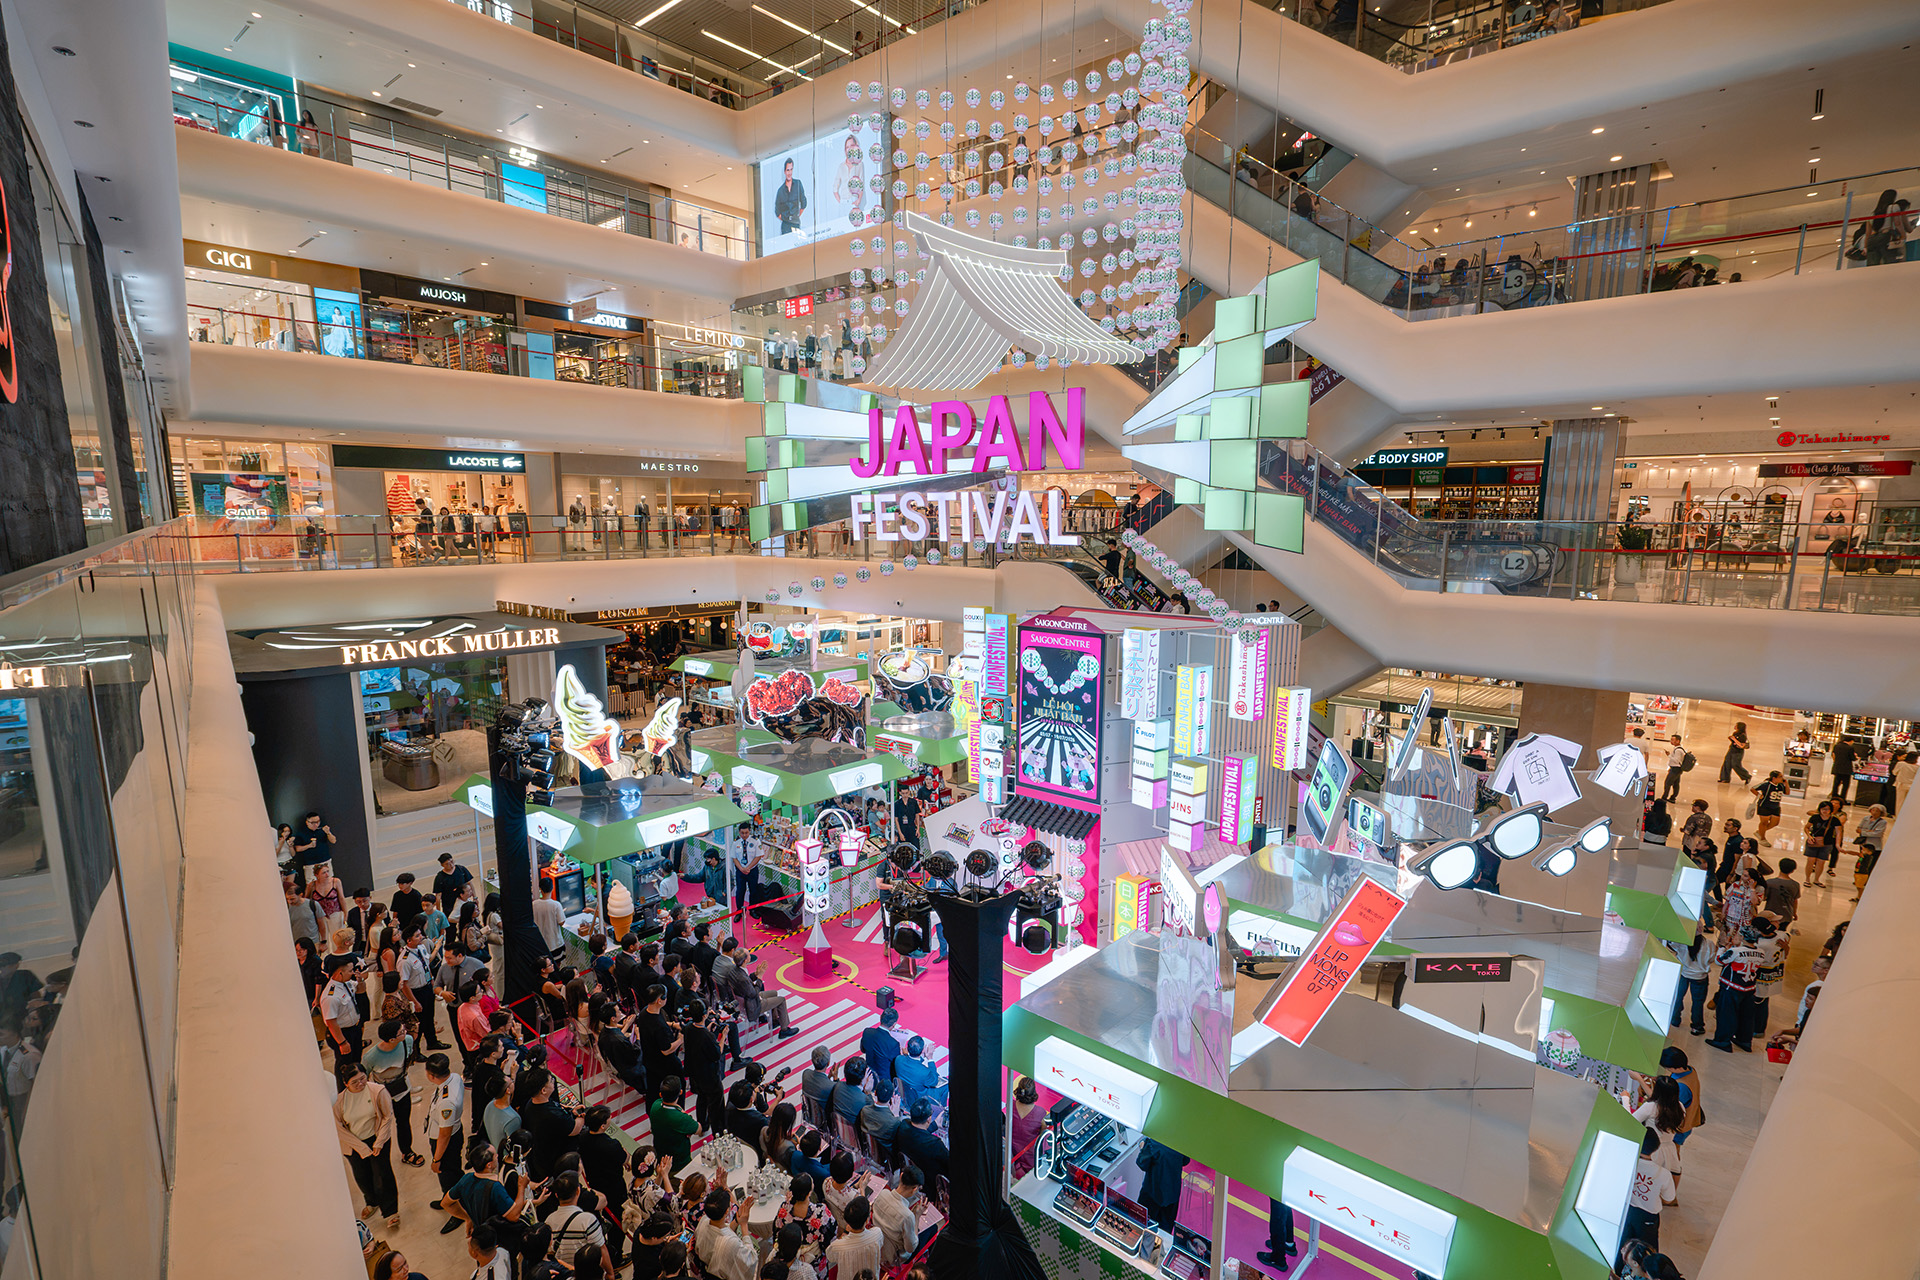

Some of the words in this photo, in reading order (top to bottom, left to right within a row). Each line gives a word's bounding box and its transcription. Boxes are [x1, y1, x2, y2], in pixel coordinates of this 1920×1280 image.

[206, 249, 251, 270] GIGI
[1503, 275, 1524, 290] L3
[420, 287, 466, 303] MUJOSH
[685, 327, 745, 349] LEMINO
[486, 354, 507, 366] SALE
[849, 387, 1086, 478] JAPAN
[1798, 432, 1890, 445] Takashimaya
[449, 457, 499, 467] LACOSTE
[641, 463, 699, 473] MAESTRO
[1360, 454, 1376, 465] HE
[1378, 453, 1410, 465] BODY
[1411, 452, 1445, 464] SHOP
[225, 508, 267, 520] SALE
[850, 490, 1081, 546] FESTIVAL
[1504, 558, 1525, 570] L2
[1035, 618, 1088, 631] SAIGONCENTRE
[341, 636, 456, 665] FRANCK
[463, 627, 561, 652] MULLER
[1031, 634, 1090, 649] SAIGONCENTRE
[988, 626, 1006, 692] JAPANFESTIVAL
[1125, 631, 1145, 719] 日本祭り
[1146, 632, 1158, 718] こんにちは
[1238, 646, 1248, 700] Takashima
[1254, 637, 1267, 717] JAPANFESTIVAL
[1141, 731, 1155, 739] PILOT
[1274, 696, 1289, 769] JAPANFESTIVAL
[1171, 801, 1192, 814] J!NS
[1221, 765, 1239, 842] JAPANFESTIVAL
[431, 833, 453, 843] PLEASE
[453, 830, 468, 838] MIND
[1247, 931, 1301, 956] FUFILM
[1323, 945, 1349, 963] LIP
[1310, 953, 1350, 982] MONS
[1426, 963, 1502, 972] KATE
[1307, 982, 1323, 995] 07
[1315, 969, 1338, 991] TER
[1052, 1066, 1120, 1105] KATE
[1098, 1096, 1121, 1110] TOKYO
[1309, 1189, 1411, 1243] KATE
[1378, 1231, 1411, 1251] TOKYO
